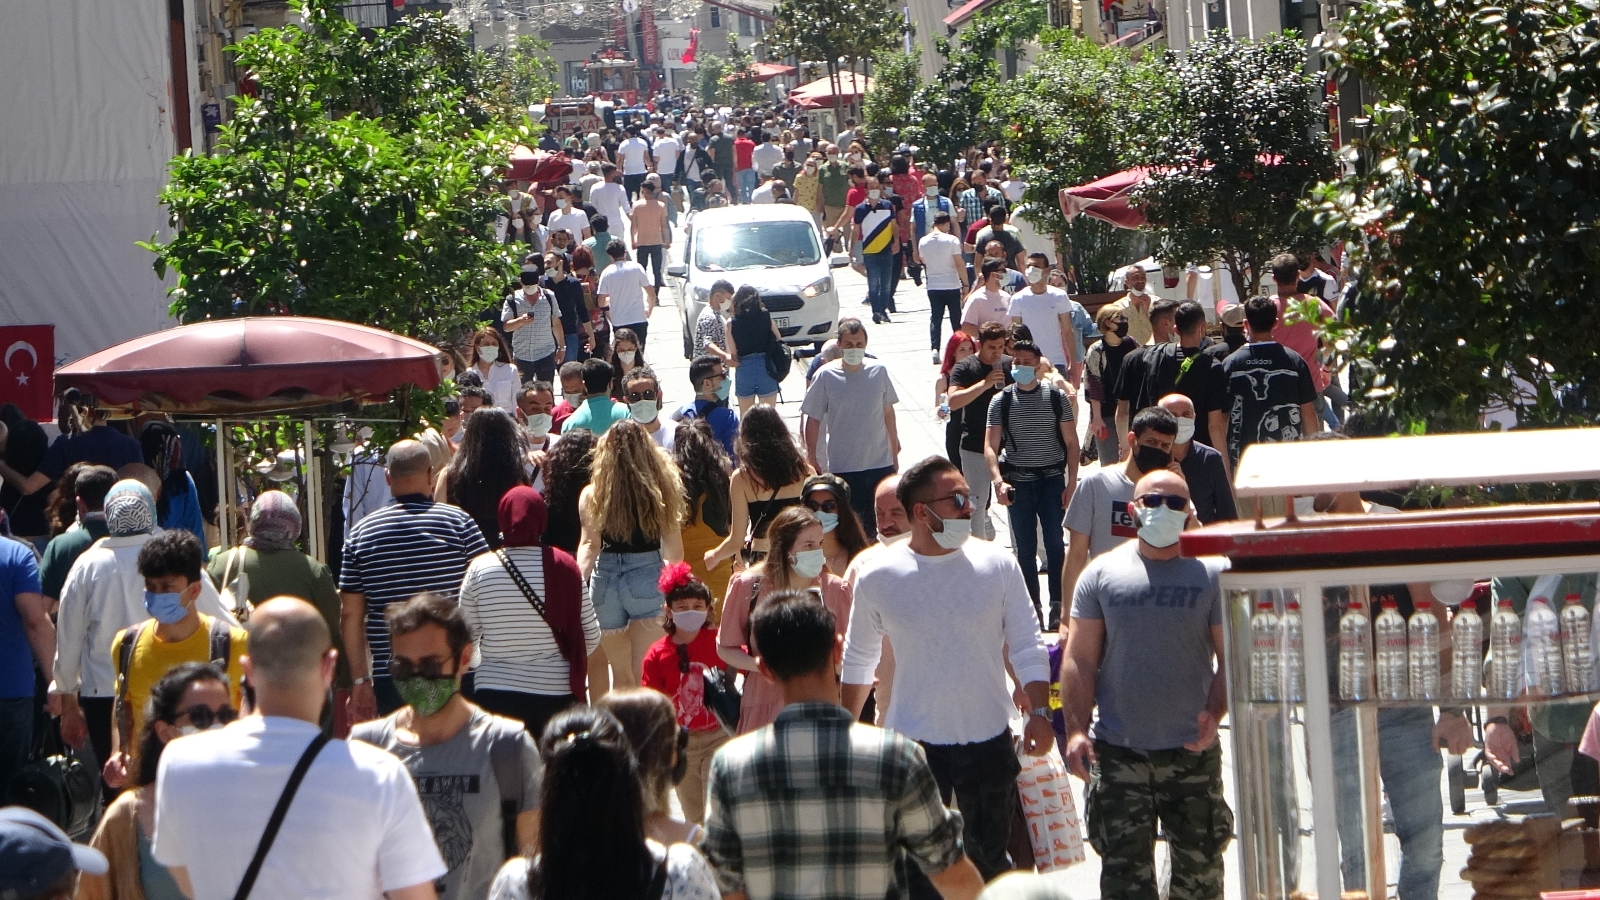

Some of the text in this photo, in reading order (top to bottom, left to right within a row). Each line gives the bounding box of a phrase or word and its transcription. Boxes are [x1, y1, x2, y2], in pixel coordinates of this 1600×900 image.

[1112, 512, 1132, 526] Le
[1108, 585, 1203, 608] EXPERT
[432, 776, 471, 793] AWAY
